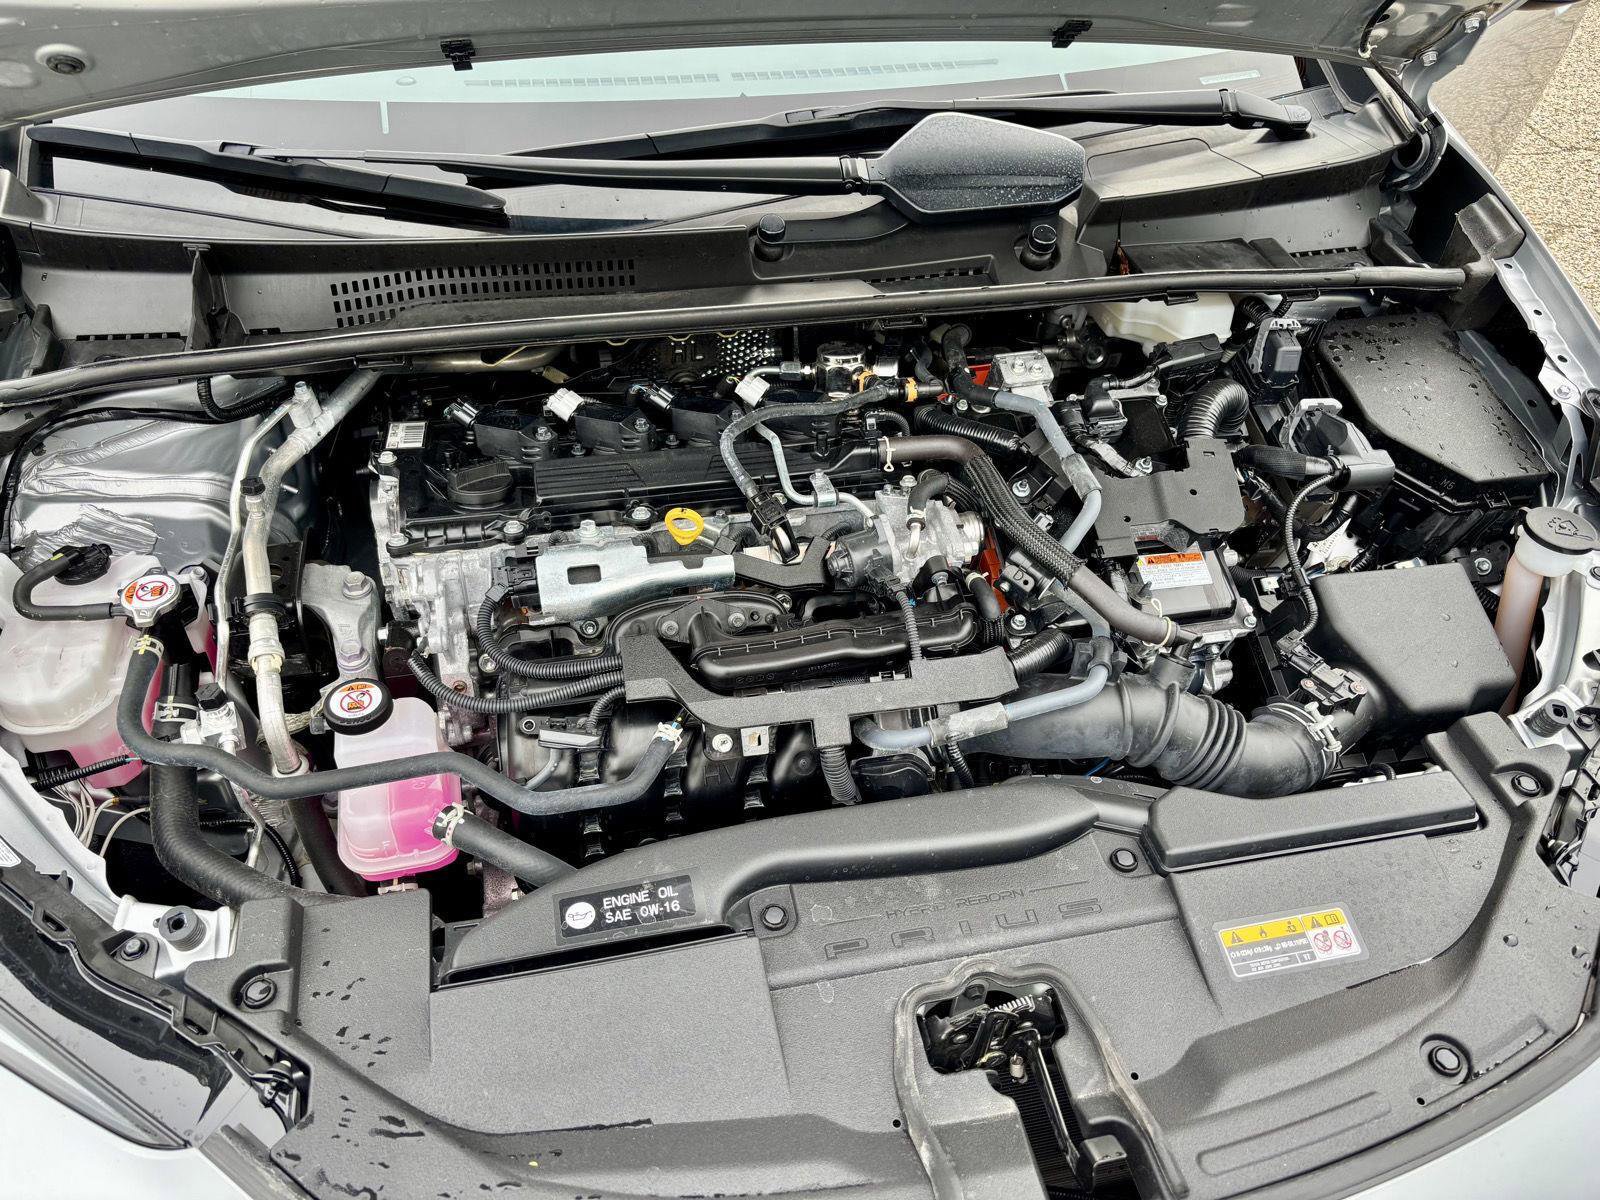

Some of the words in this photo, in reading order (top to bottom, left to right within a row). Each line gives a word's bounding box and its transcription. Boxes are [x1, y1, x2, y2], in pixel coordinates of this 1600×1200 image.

[603, 891, 650, 909] ENGINE
[658, 886, 678, 898] OIL
[885, 903, 946, 920] HYBRID
[955, 888, 1025, 908] REBORN
[605, 908, 632, 924] SAE
[640, 900, 680, 917] 0W-16
[824, 898, 1103, 960] PRIUS
